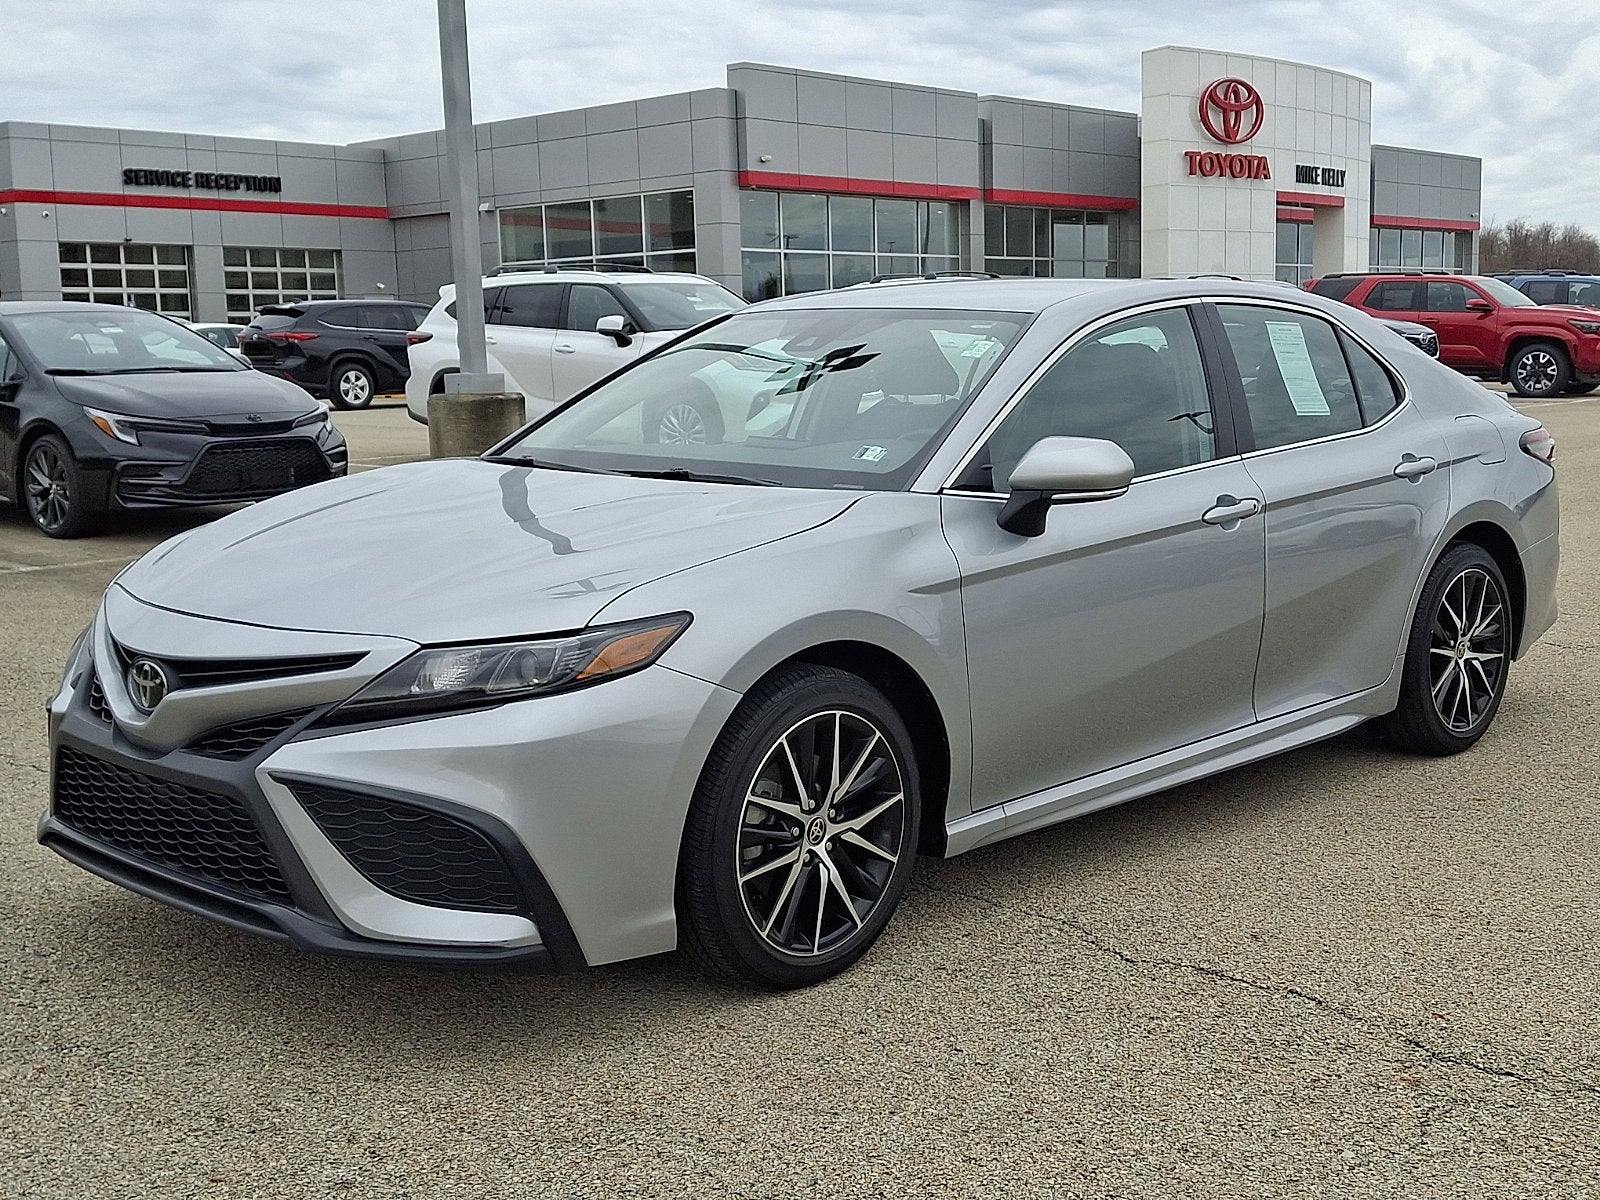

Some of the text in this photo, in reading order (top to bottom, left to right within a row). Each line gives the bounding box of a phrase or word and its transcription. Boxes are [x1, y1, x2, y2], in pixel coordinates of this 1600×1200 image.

[1185, 151, 1271, 180] TOYOTA
[1295, 164, 1346, 188] MIKE KELLY
[123, 168, 282, 193] SERVICE RECEPTION
